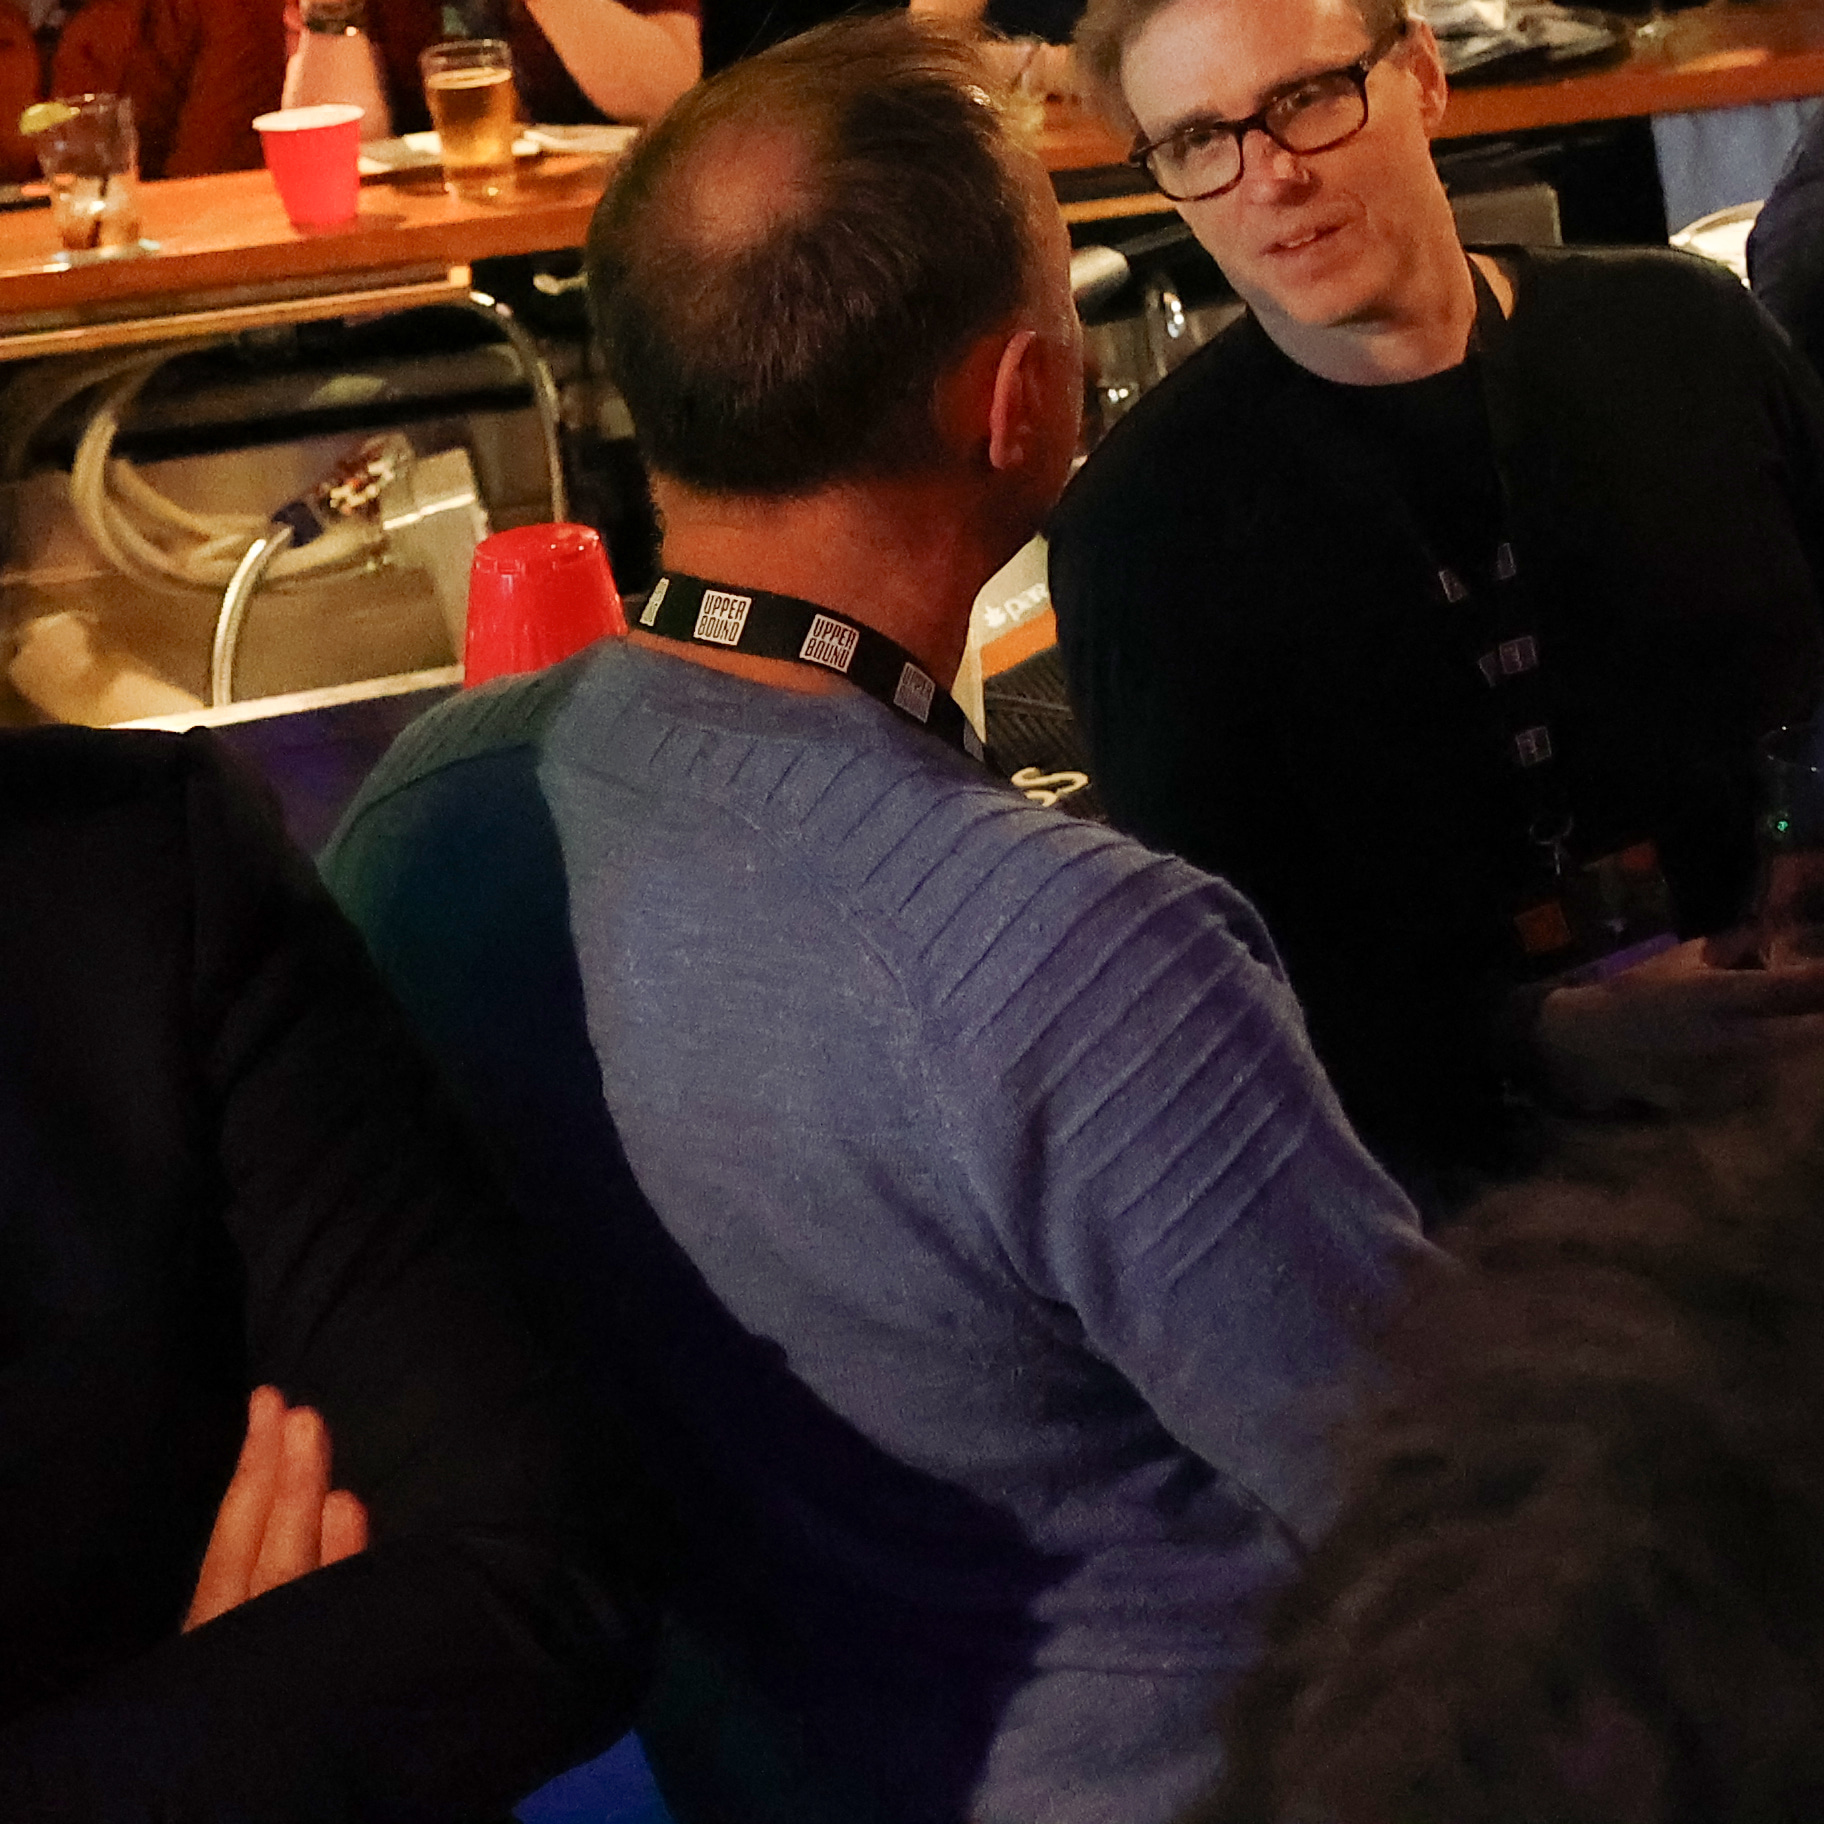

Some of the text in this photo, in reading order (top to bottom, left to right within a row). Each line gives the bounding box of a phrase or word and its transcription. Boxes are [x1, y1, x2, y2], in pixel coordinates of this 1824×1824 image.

[703, 593, 747, 622] UPPER
[697, 615, 740, 642] BOUND
[812, 618, 858, 649] UPPER
[804, 637, 850, 669] BOUND
